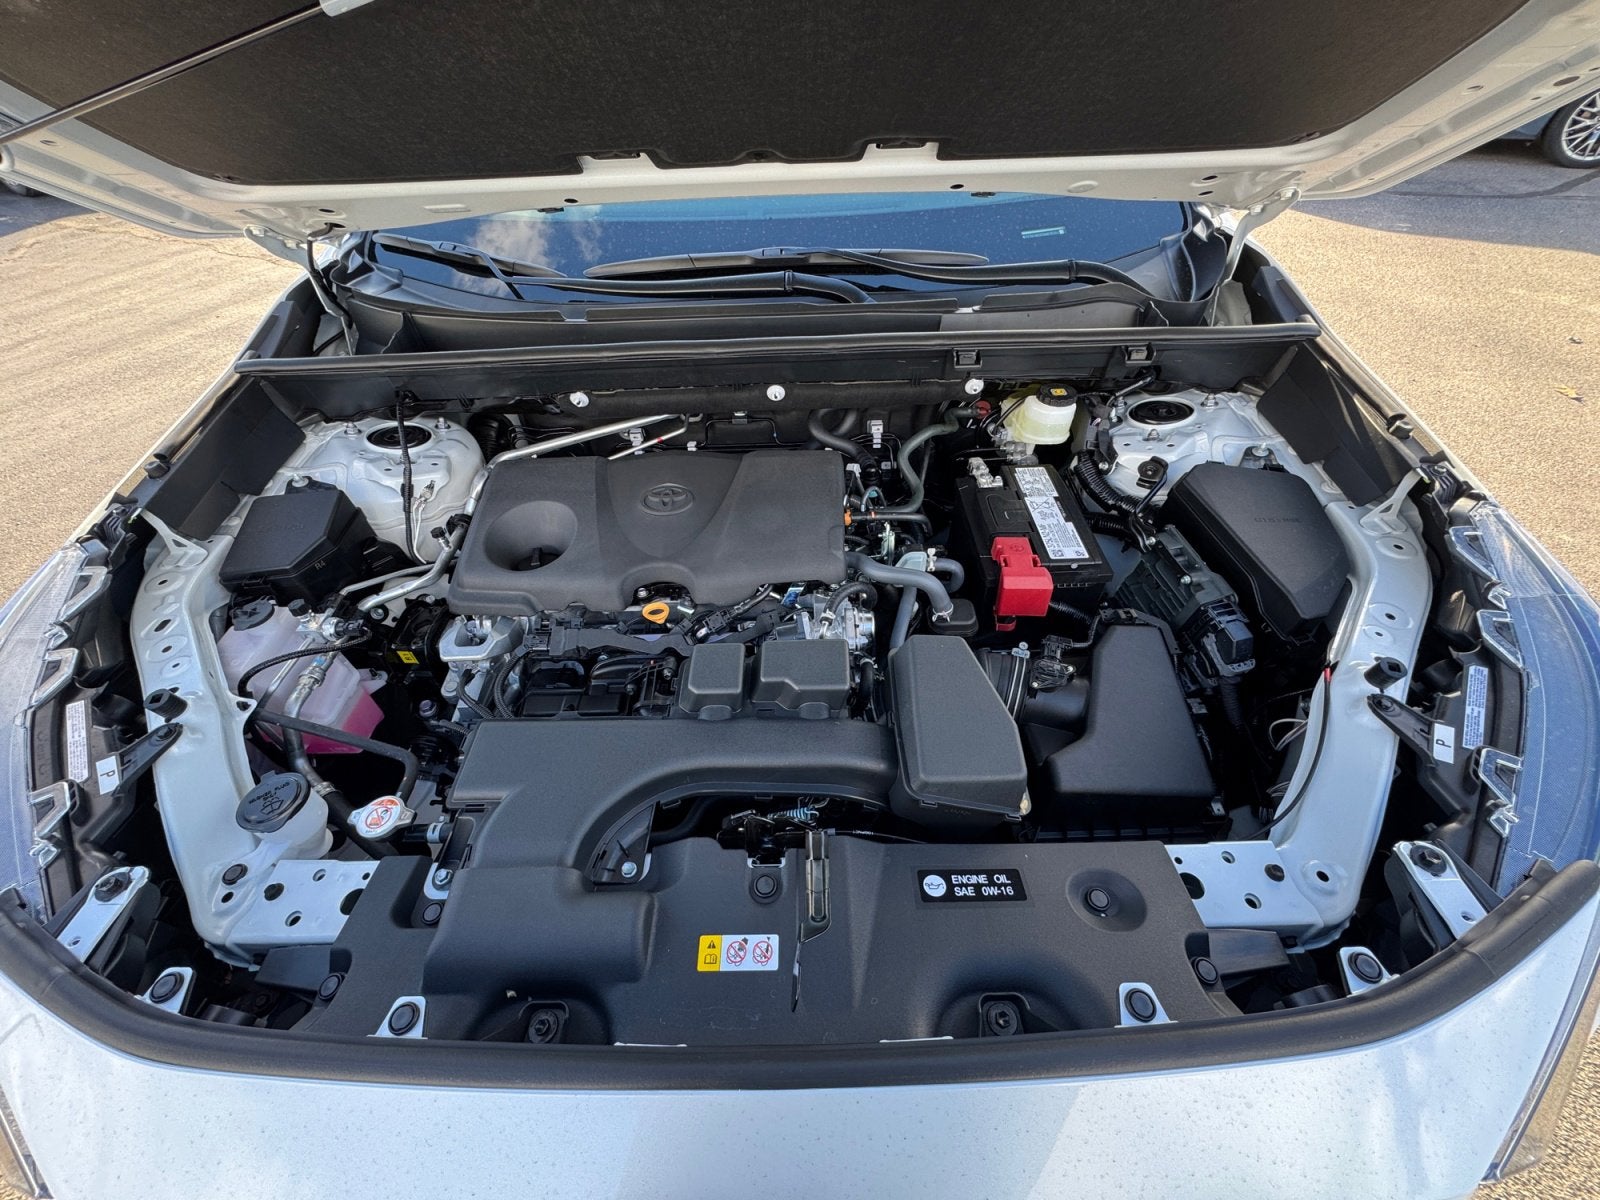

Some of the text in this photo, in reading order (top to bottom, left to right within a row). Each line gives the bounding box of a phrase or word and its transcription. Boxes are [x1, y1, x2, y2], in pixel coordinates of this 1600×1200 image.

[1435, 738, 1452, 749] P
[99, 769, 116, 778] P
[951, 874, 1011, 884] ENGINE OIL
[954, 886, 1014, 896] SAE 0W-16
